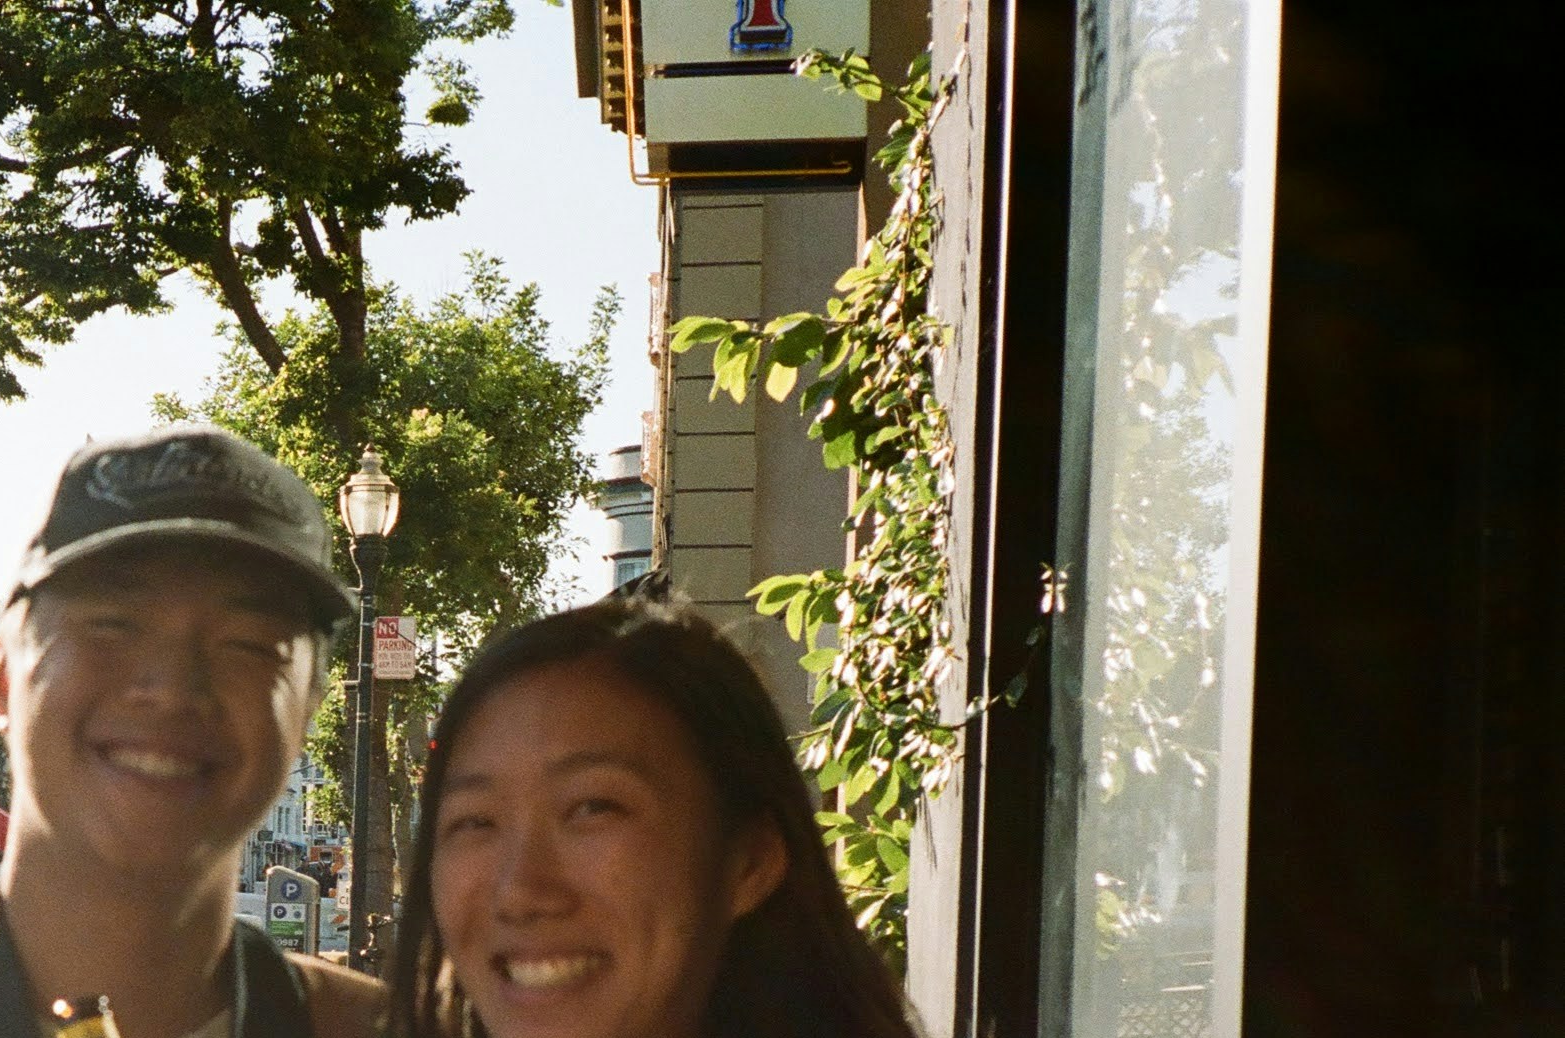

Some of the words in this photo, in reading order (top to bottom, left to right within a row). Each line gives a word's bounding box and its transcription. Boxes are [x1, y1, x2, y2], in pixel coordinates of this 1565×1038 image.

[378, 621, 397, 635] NO
[378, 640, 413, 651] PARKING
[285, 883, 297, 897] P
